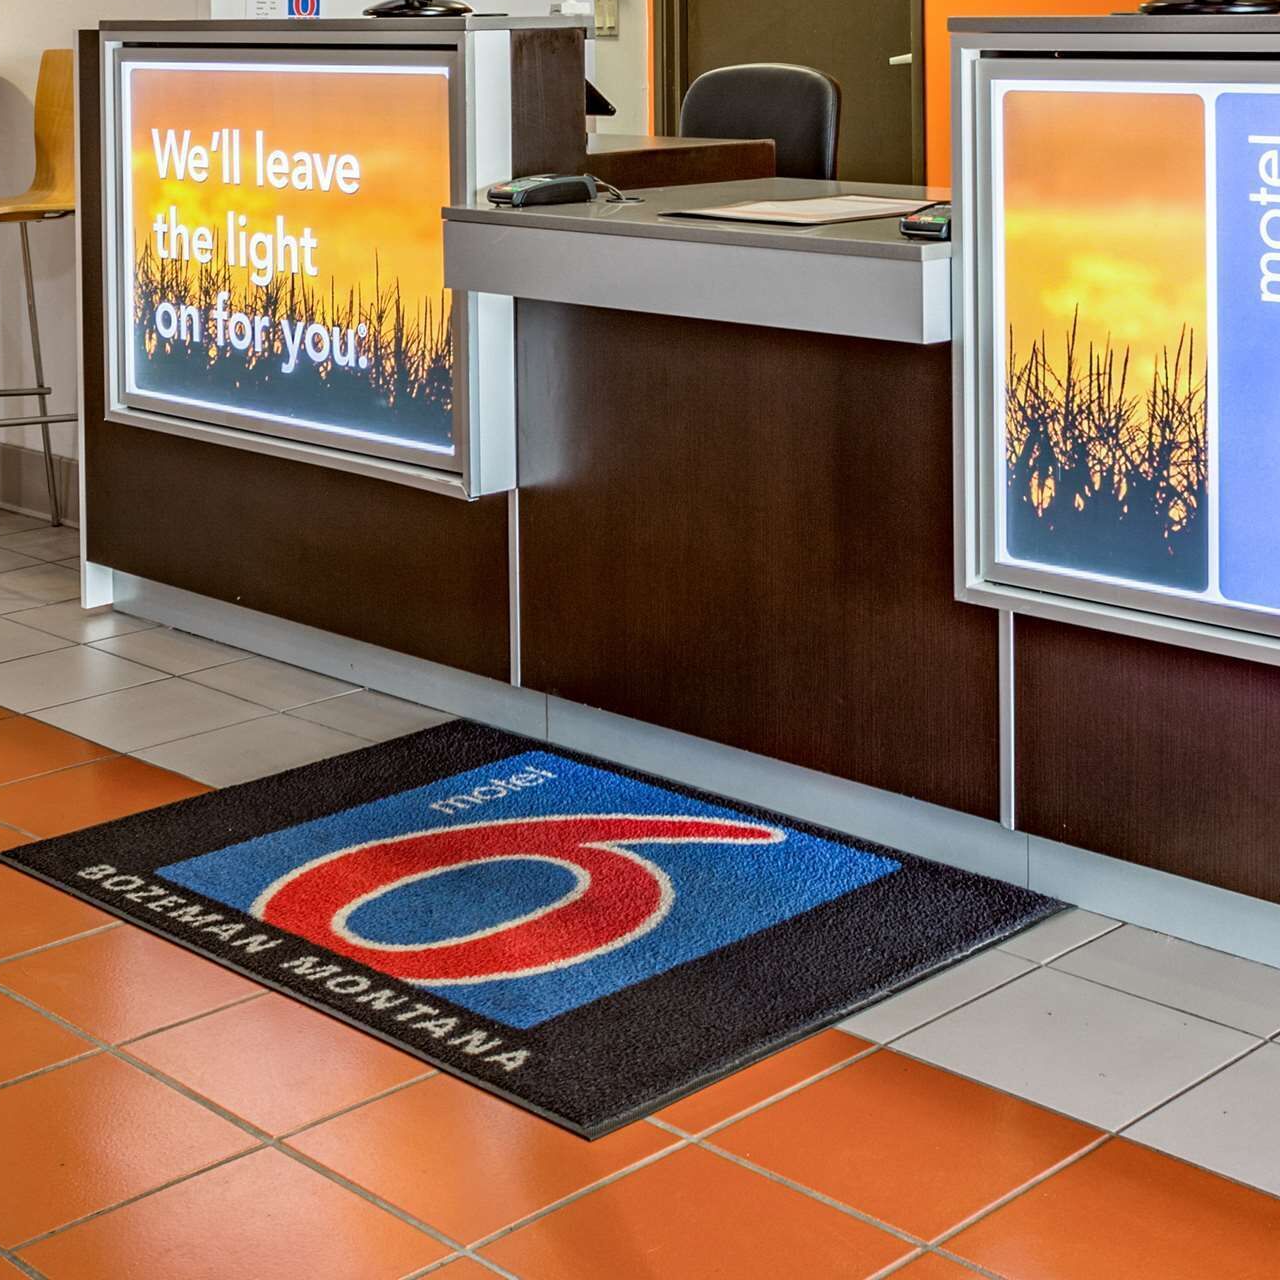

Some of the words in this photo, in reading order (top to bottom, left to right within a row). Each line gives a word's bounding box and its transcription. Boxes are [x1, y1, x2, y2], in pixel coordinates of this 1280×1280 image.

[152, 128, 242, 186] We'll
[256, 130, 361, 195] leave
[153, 205, 214, 264] the
[227, 210, 319, 288] light
[155, 300, 201, 343] on
[213, 291, 270, 354] for
[431, 765, 558, 815] motel
[250, 812, 786, 987] 6
[77, 862, 283, 955] BOZEMAN
[279, 954, 532, 1073] MONTANA
